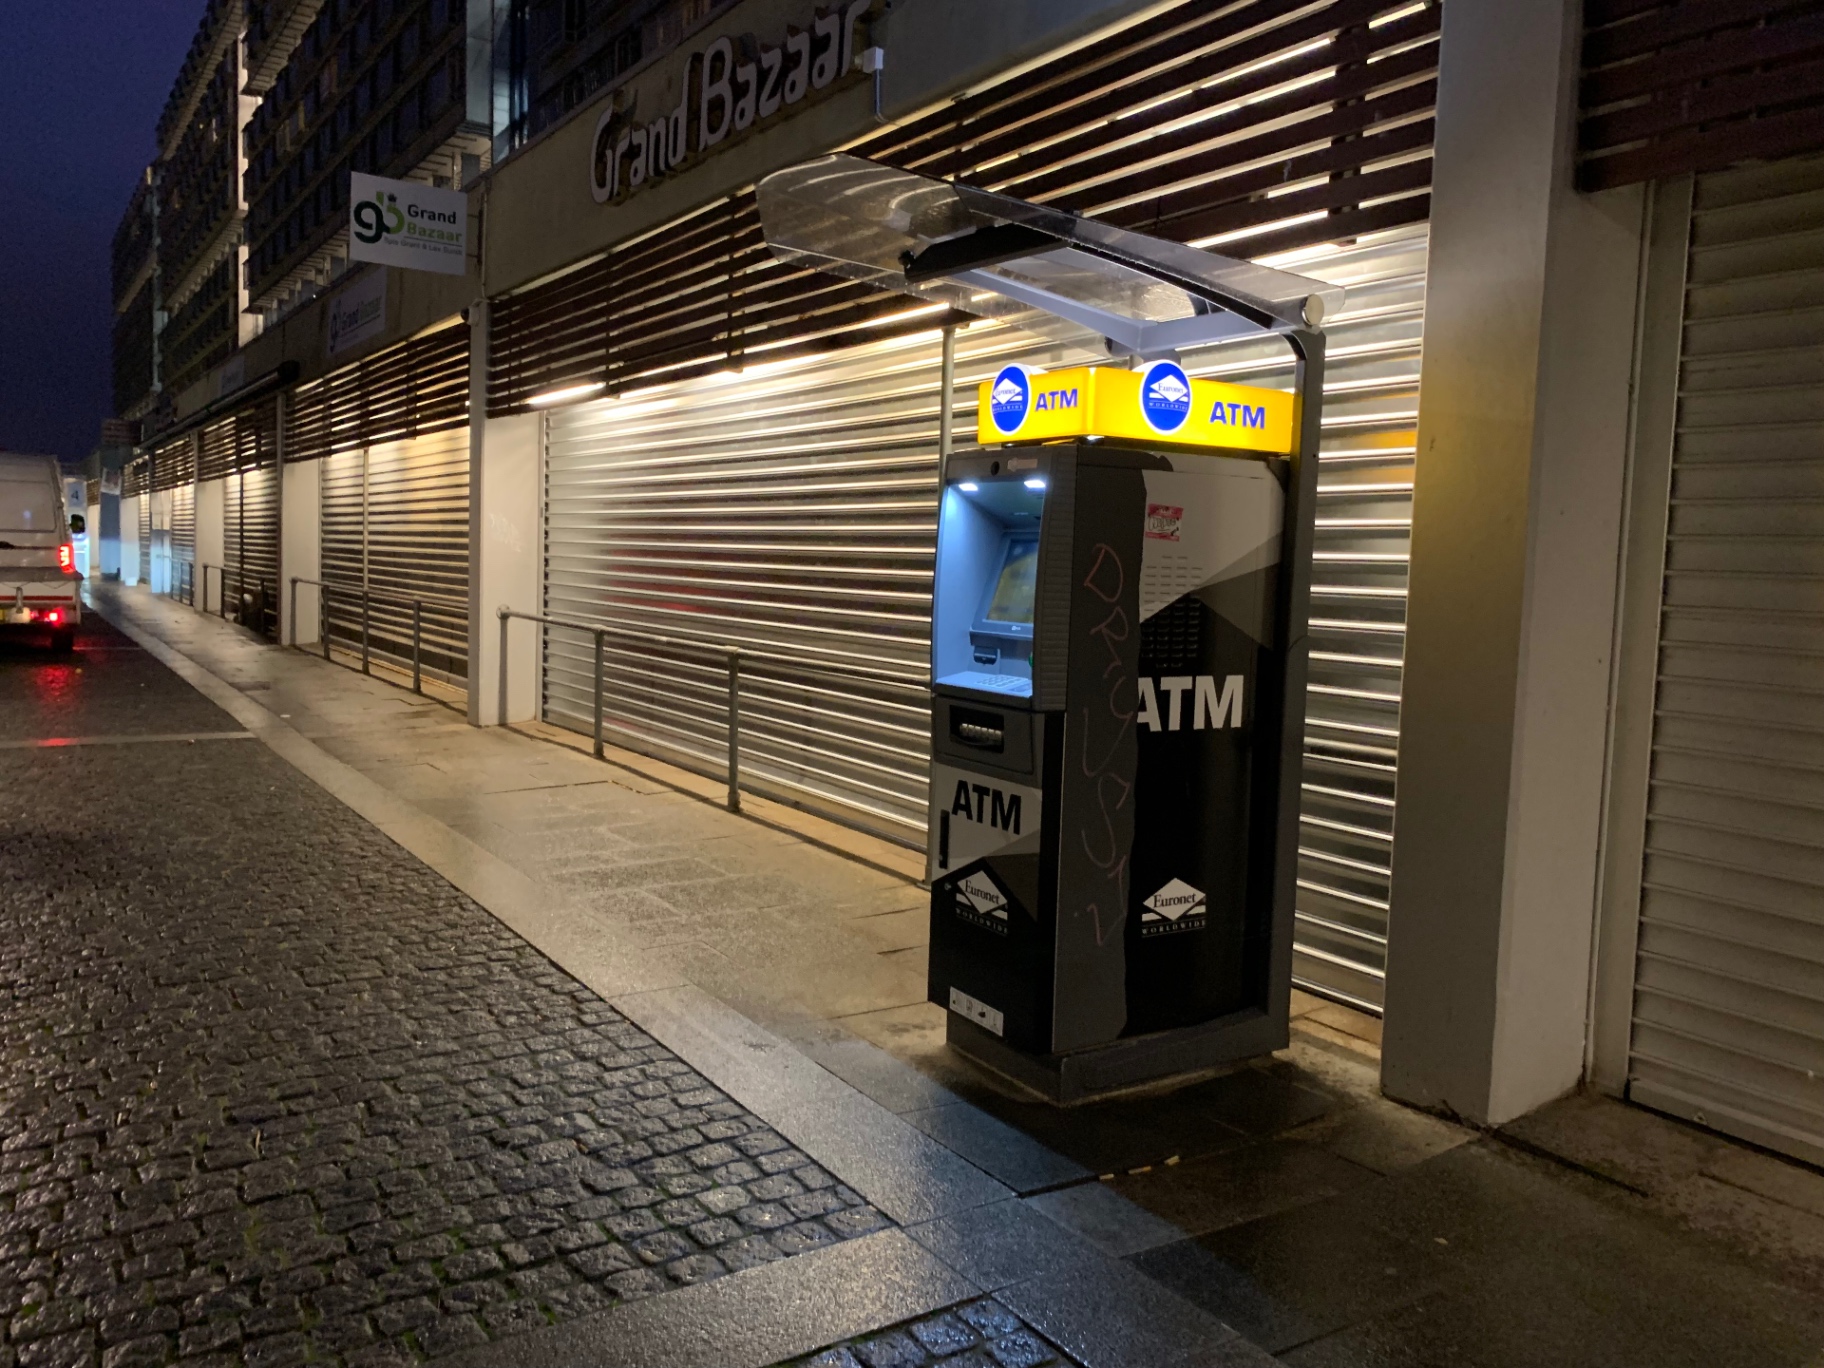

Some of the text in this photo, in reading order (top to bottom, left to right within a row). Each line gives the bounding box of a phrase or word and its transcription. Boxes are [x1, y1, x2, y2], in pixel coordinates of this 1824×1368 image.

[590, 0, 871, 203] Grand Bazaar
[407, 204, 457, 225] Grand
[407, 221, 463, 243] Bazaar
[1035, 388, 1078, 412] ATM
[1158, 382, 1184, 394] Euronet
[1209, 401, 1265, 429] ATM
[1137, 675, 1244, 732] ATM
[952, 780, 1022, 835] ATM
[964, 880, 1001, 904] Euronet
[1153, 893, 1196, 908] Euronet
[956, 907, 1008, 934] WORLDWIDE
[1142, 920, 1205, 934] WORLDWIDE
